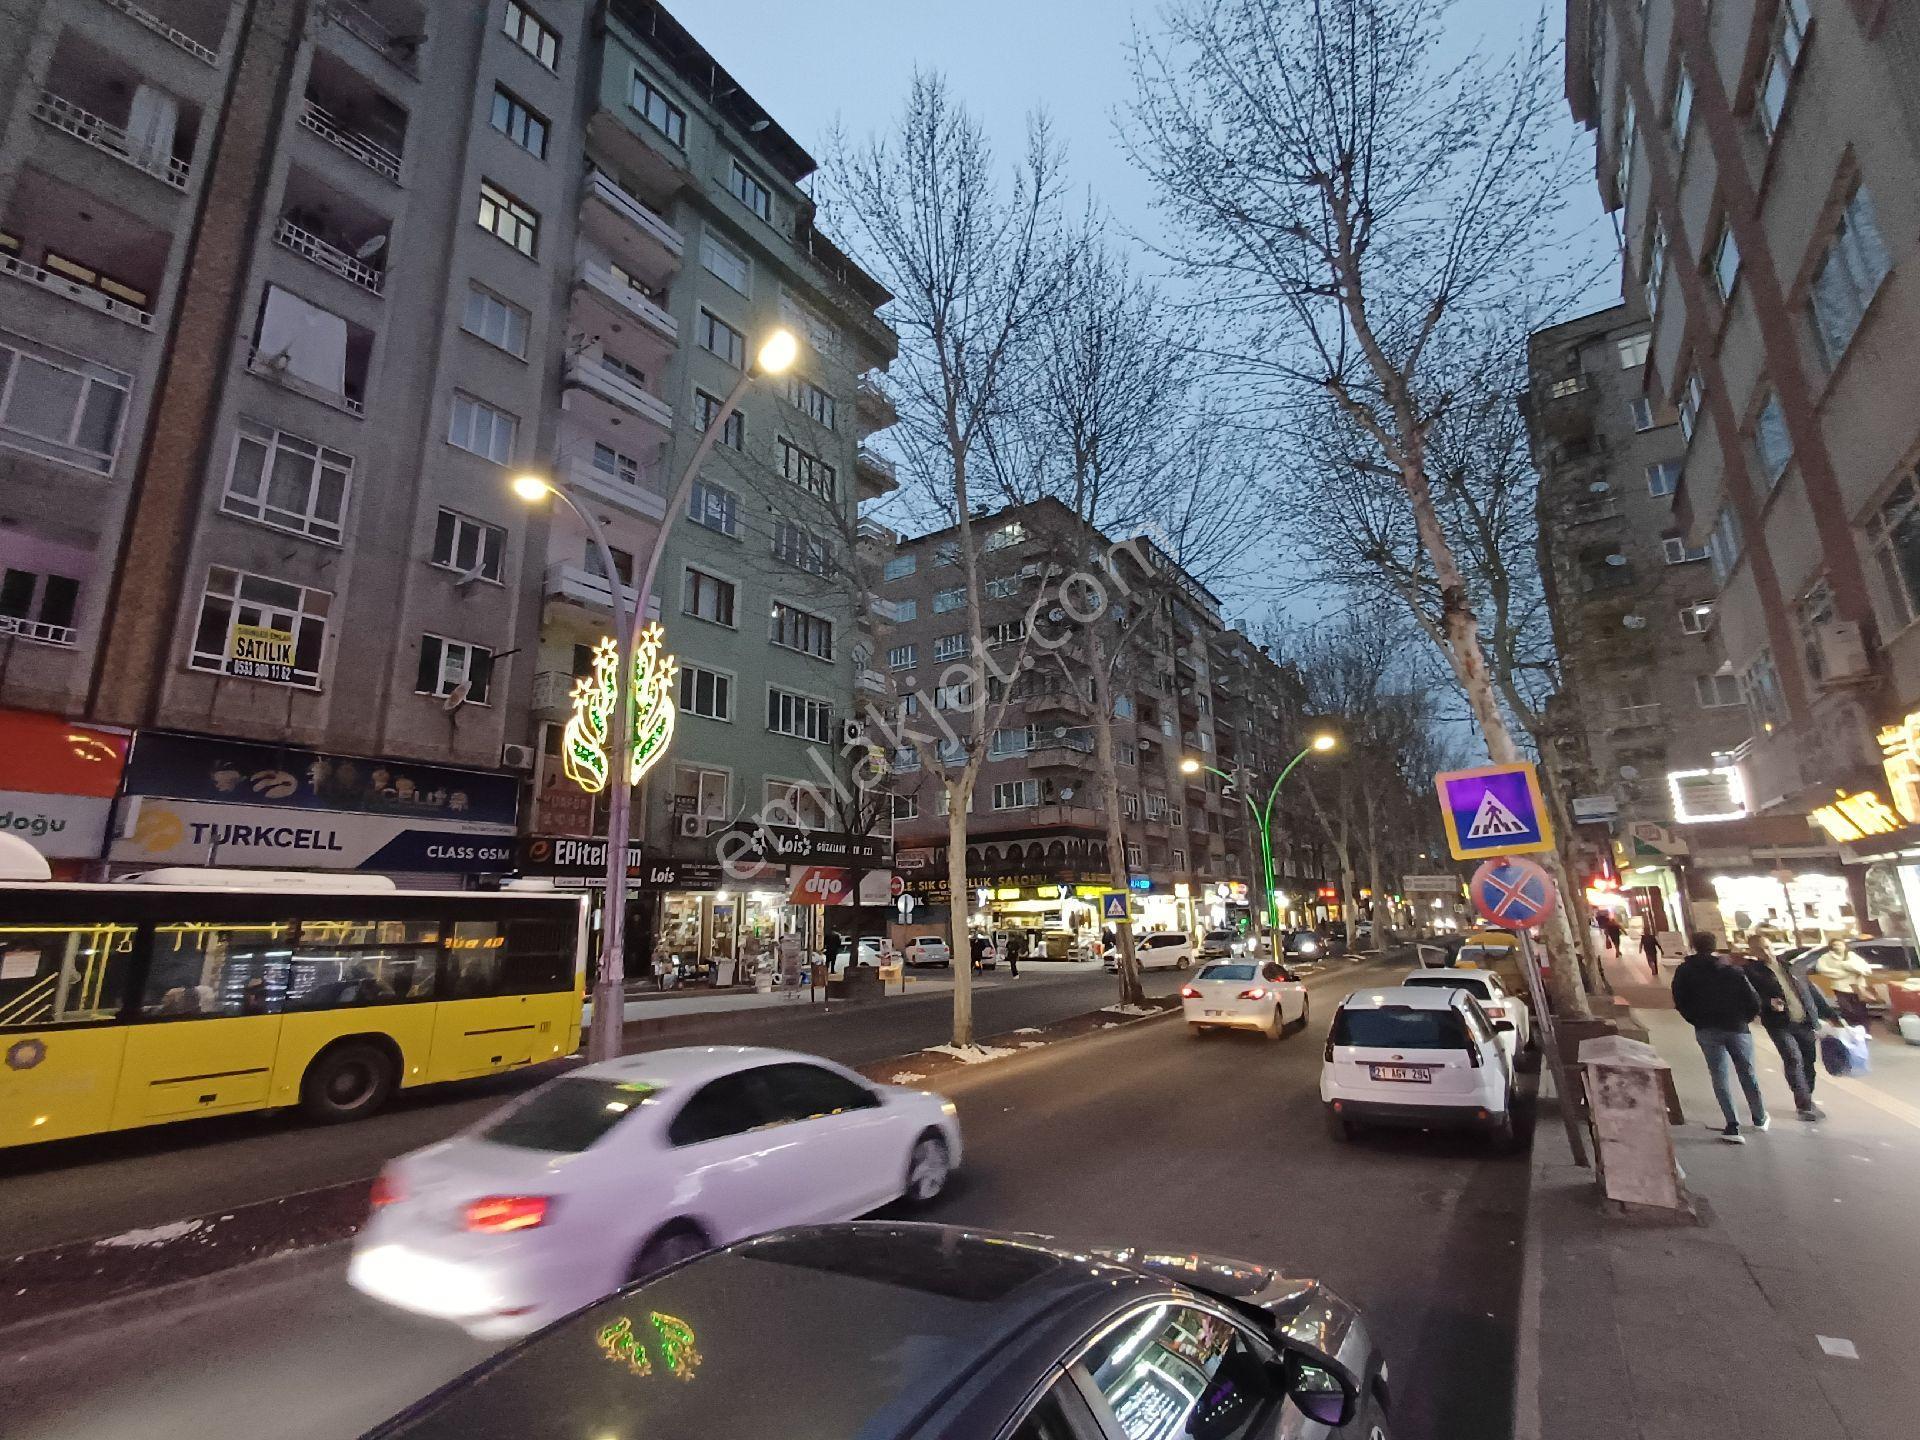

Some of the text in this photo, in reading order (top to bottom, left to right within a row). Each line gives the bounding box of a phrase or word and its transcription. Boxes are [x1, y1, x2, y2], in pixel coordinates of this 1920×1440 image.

[236, 637, 292, 664] SATILIK
[190, 822, 343, 851] TURKCELL
[778, 833, 804, 854] Lois
[427, 845, 510, 860] CLASS GSM
[554, 840, 642, 867] EPitelm
[650, 865, 676, 884] Lois
[805, 870, 843, 901] dyo
